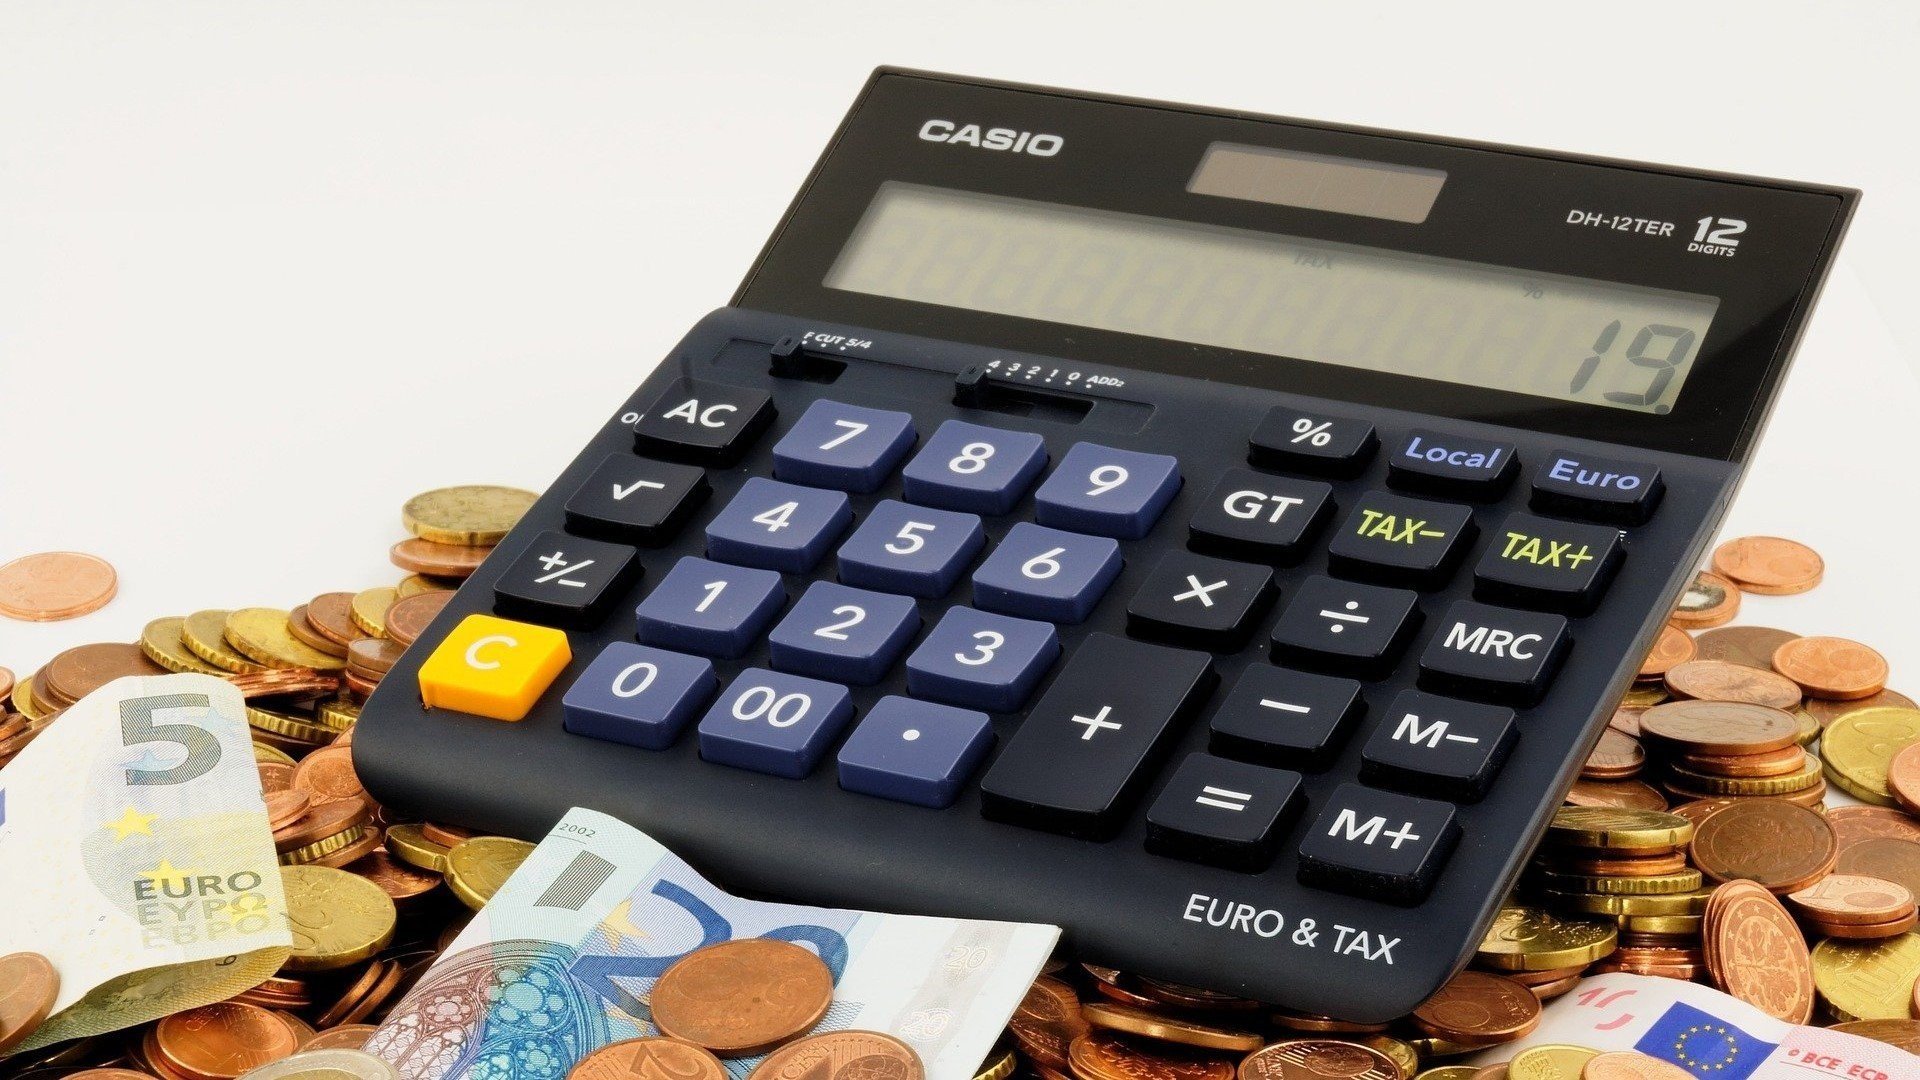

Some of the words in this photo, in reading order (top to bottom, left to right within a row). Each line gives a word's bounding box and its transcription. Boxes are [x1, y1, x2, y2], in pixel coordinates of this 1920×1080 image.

[919, 120, 1063, 156] CASIO
[1567, 210, 1674, 236] DH-12TER
[1691, 217, 1747, 247] 12
[1687, 241, 1737, 258] DIGITS
[803, 330, 816, 339] F
[815, 333, 845, 345] CUT
[988, 360, 1002, 369] 4
[1008, 362, 1022, 372] 3
[1027, 366, 1042, 375] 2
[1050, 369, 1060, 378] 1
[1068, 371, 1082, 381] 0
[618, 410, 648, 425] O
[663, 399, 737, 427] AC
[819, 420, 868, 450] 7
[949, 443, 994, 473] 8
[1406, 437, 1502, 470] Local
[1086, 466, 1128, 496] 9
[1549, 459, 1641, 492] Euro
[753, 502, 798, 532] 4
[1224, 491, 1303, 523] GT
[885, 521, 935, 554] 5
[1502, 531, 1593, 570] TAX+
[1022, 548, 1065, 579] 6
[695, 581, 727, 612] 1
[814, 606, 865, 640] 2
[465, 635, 517, 670] C
[955, 631, 1004, 665] 3
[1444, 622, 1542, 659] MRC
[612, 663, 657, 697] 0
[732, 686, 811, 727] 00
[118, 692, 222, 787] 5
[559, 823, 596, 838] 2002
[1328, 809, 1420, 849] M+
[133, 870, 262, 901] EURO
[1183, 894, 1283, 937] EURO
[1292, 918, 1319, 947] &
[1334, 925, 1401, 964] TAX
[1801, 1051, 1843, 1070] BCE
